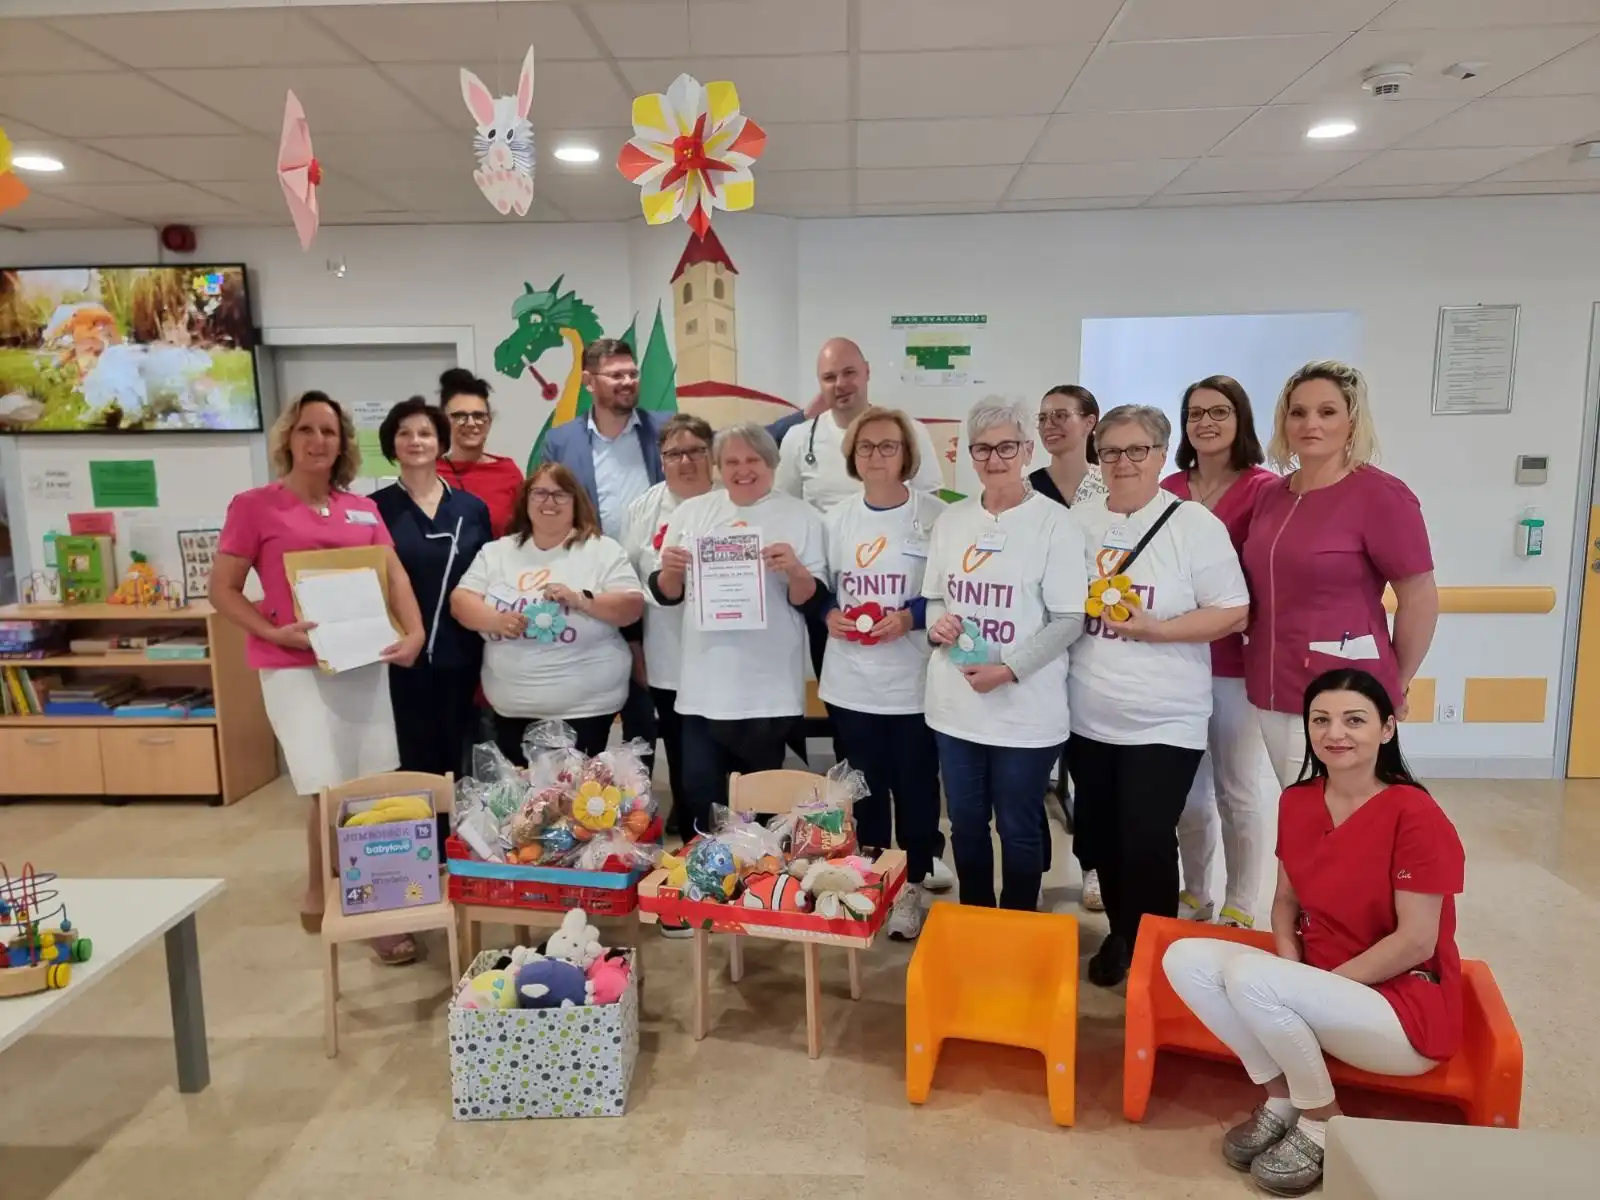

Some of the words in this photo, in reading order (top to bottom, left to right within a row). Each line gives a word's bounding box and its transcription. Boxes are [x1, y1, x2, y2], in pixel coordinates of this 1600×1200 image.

[843, 571, 906, 596] ČINITI
[947, 573, 1014, 608] ČINITI
[366, 843, 410, 854] babylove
